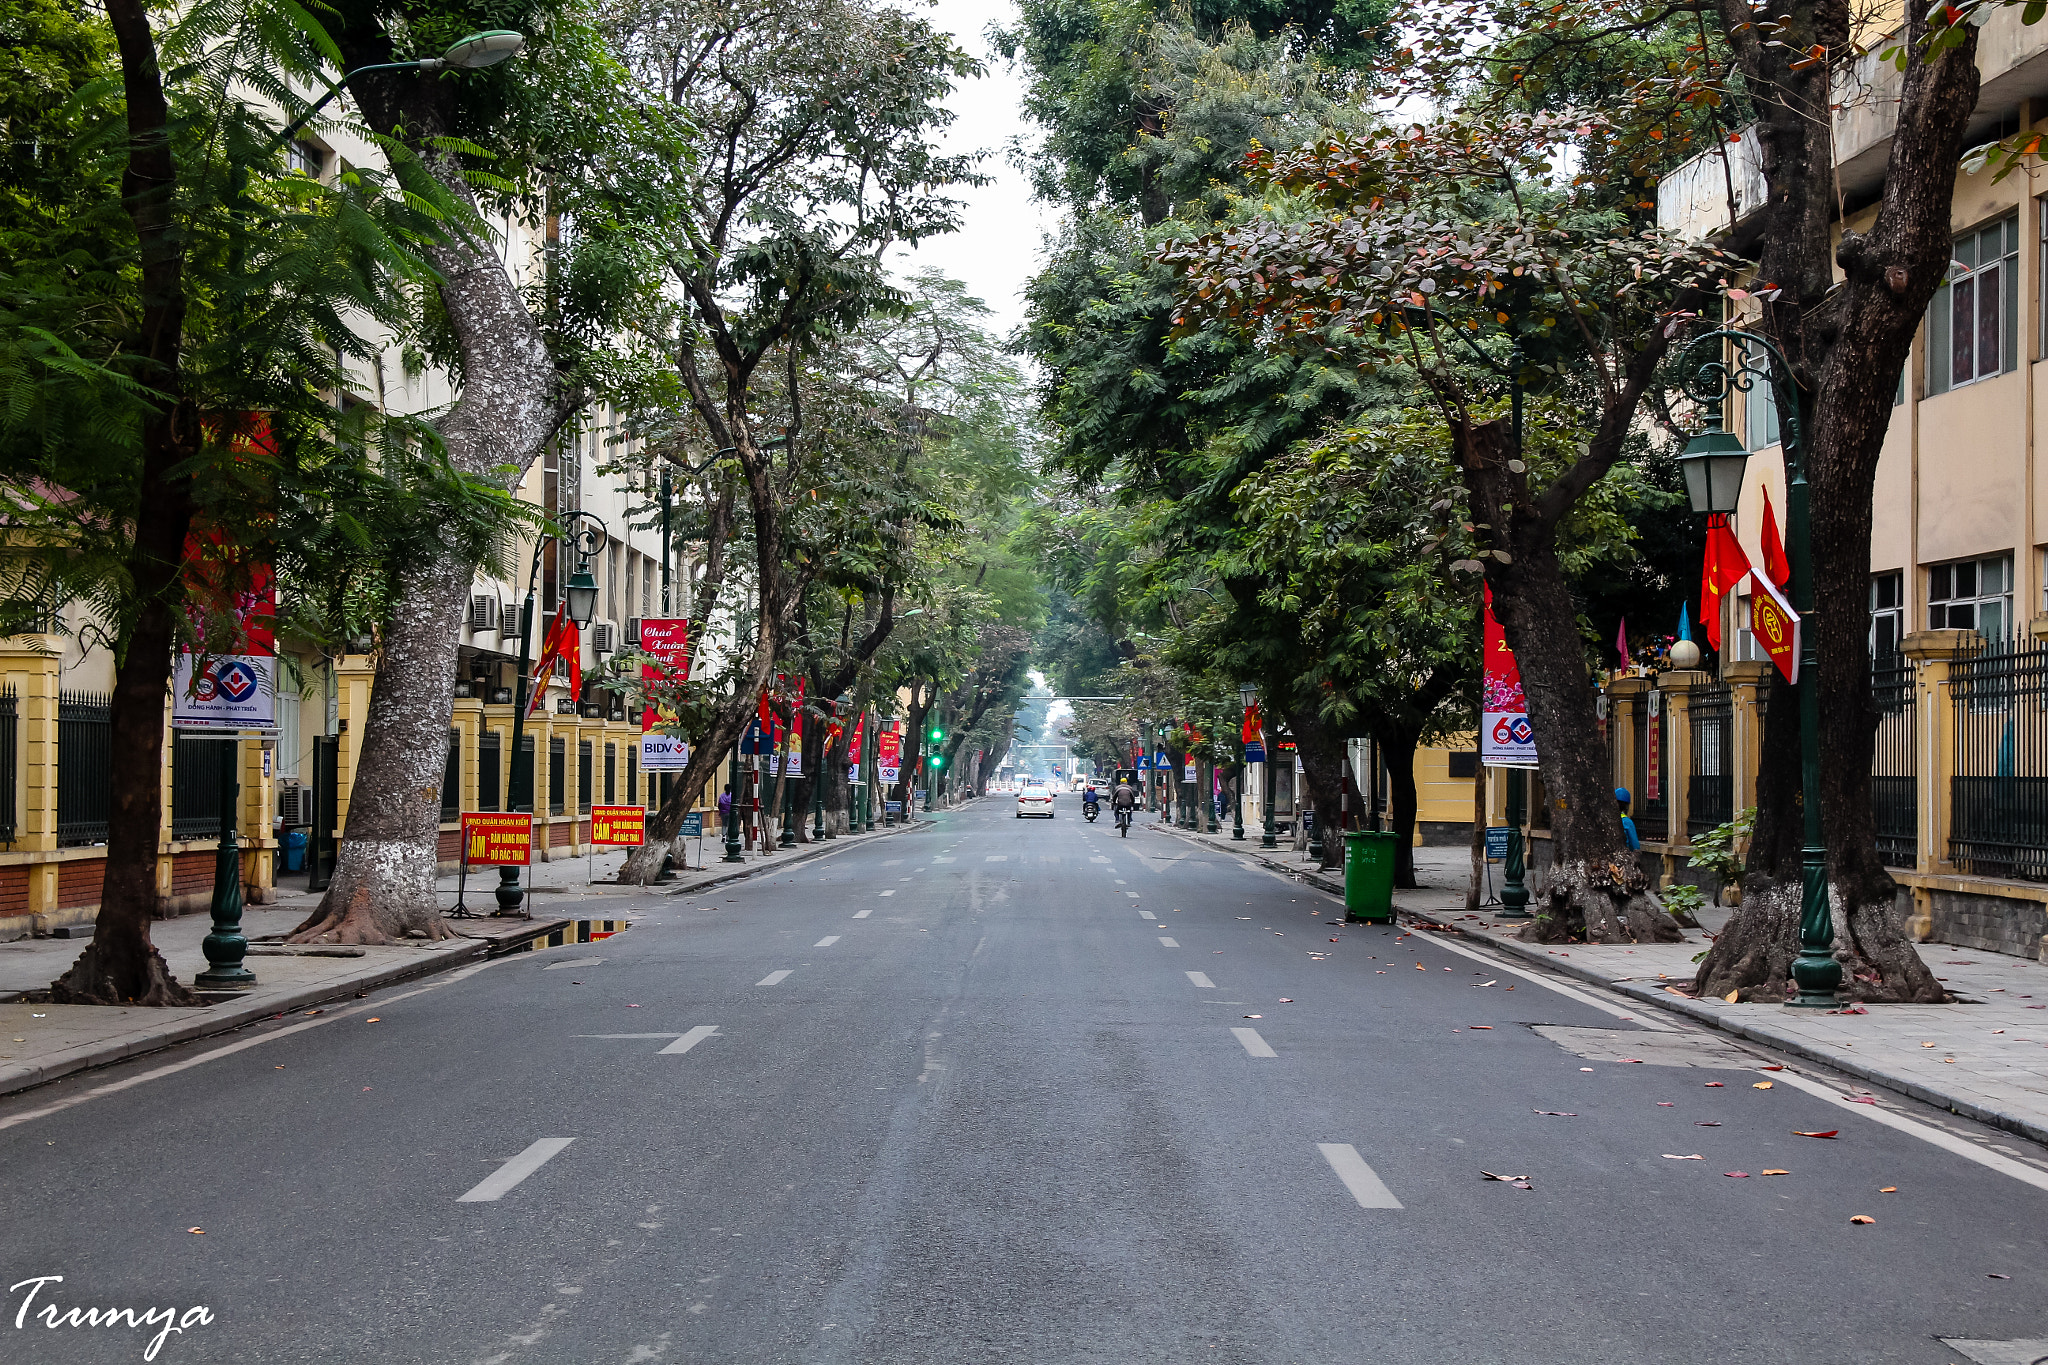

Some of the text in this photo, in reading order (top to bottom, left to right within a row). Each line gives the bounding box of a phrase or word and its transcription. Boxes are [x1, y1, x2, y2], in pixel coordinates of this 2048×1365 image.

[644, 627, 672, 637] Chào
[651, 639, 685, 650] Xuân
[644, 743, 672, 753] BIDV
[593, 816, 610, 840] CẤM
[469, 827, 486, 858] ẤM
